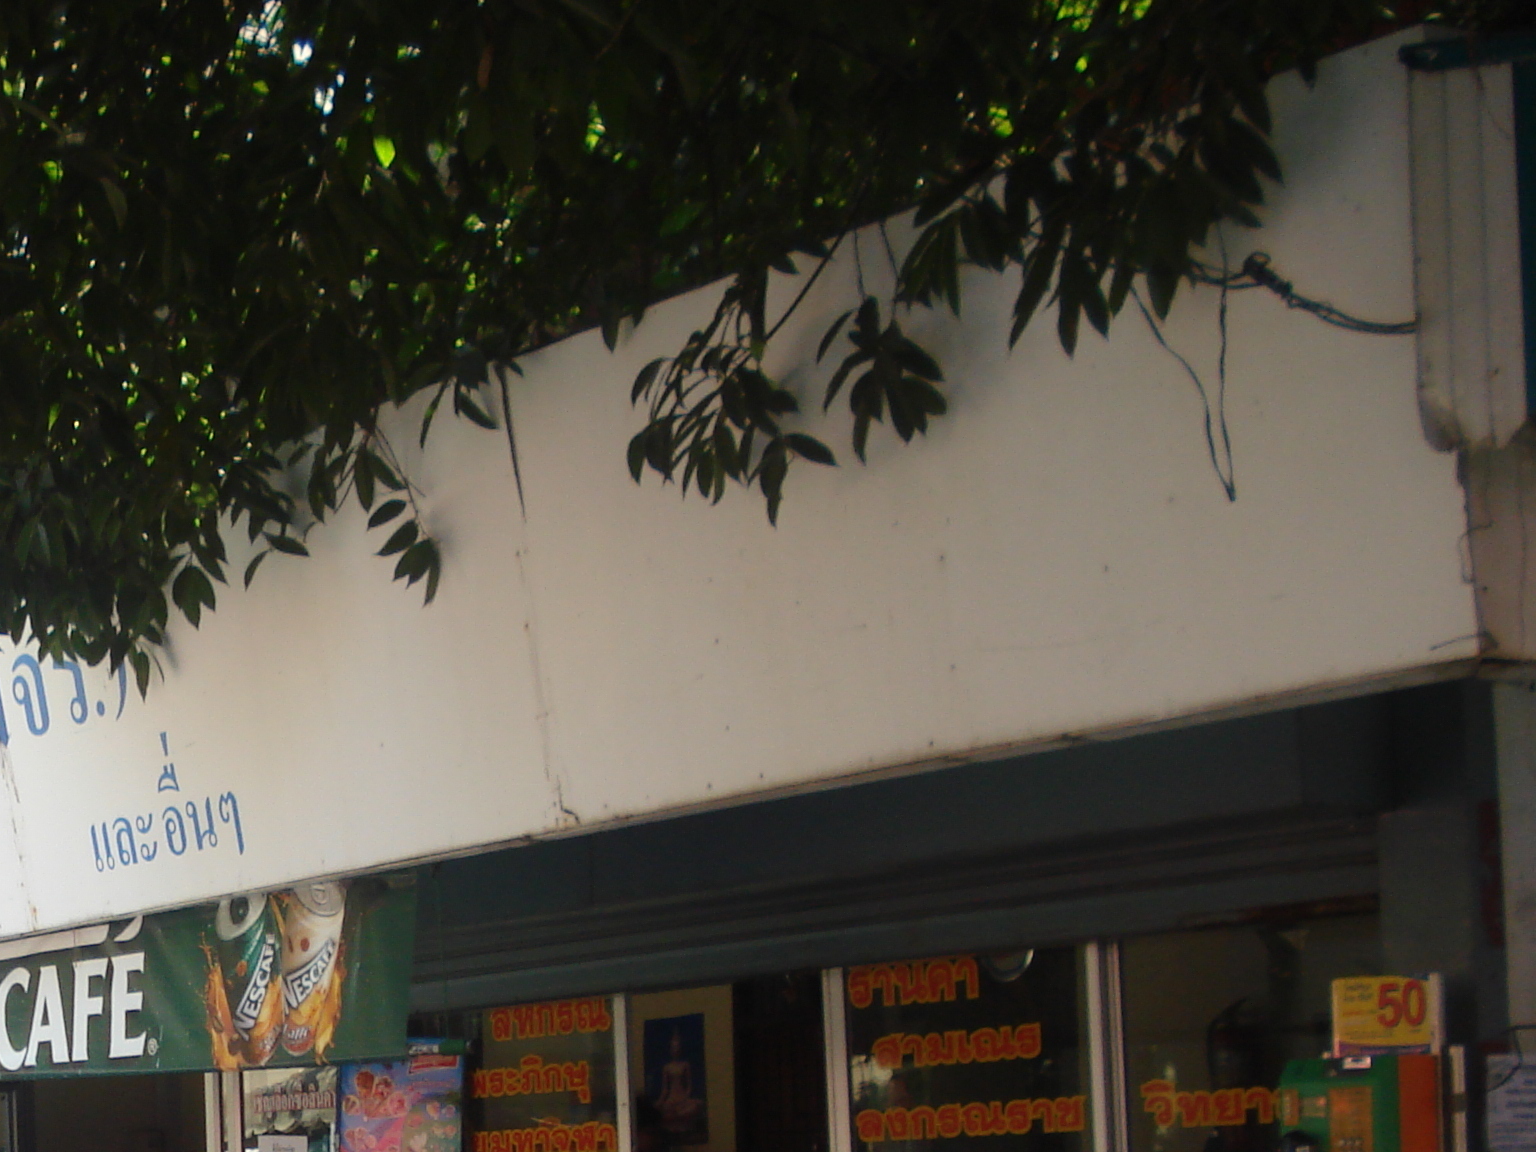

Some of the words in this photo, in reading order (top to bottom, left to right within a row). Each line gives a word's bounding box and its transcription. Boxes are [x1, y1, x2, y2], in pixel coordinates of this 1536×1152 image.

[90, 732, 245, 873] และอื่นๆ
[1377, 979, 1427, 1029] 50
[872, 1021, 1042, 1070] สามเณร
